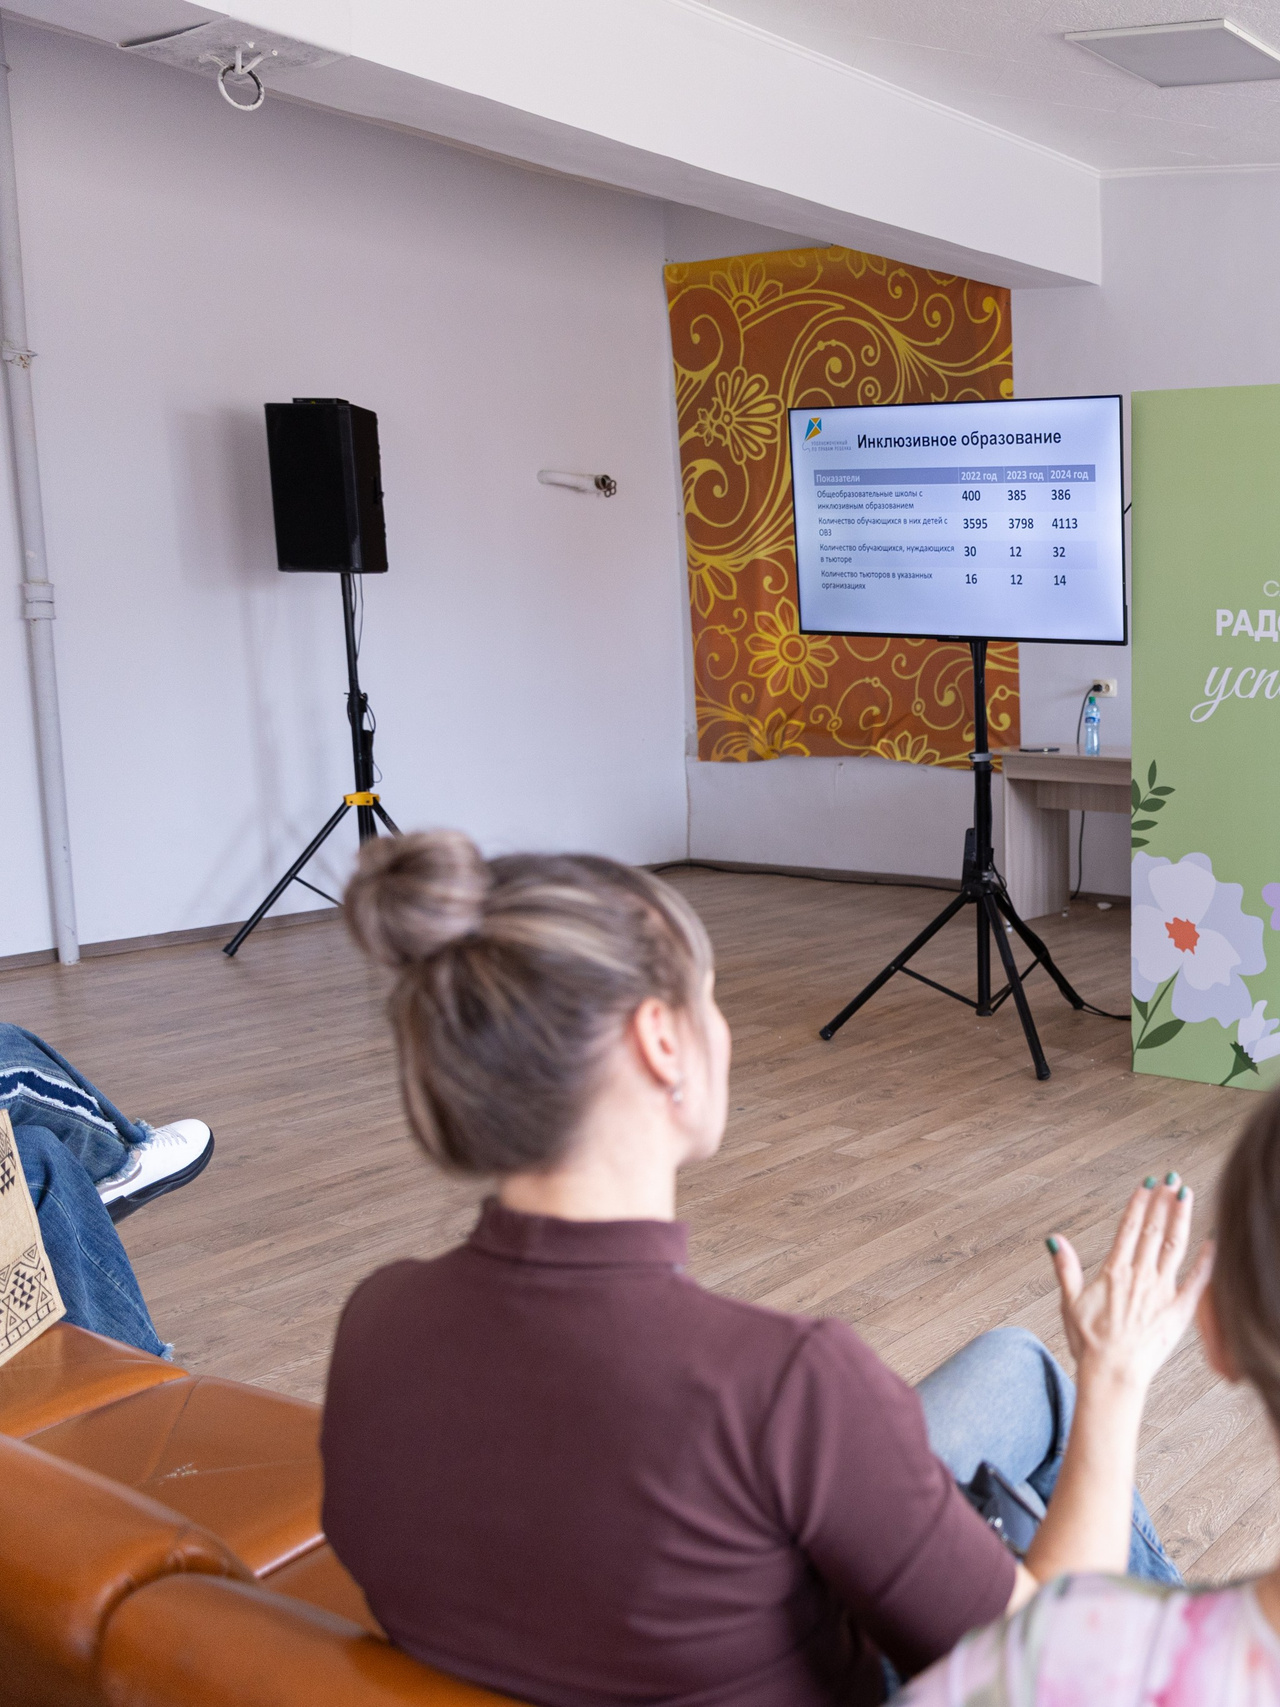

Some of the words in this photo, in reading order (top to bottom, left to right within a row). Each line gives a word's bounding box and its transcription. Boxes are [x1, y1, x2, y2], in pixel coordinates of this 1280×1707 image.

[858, 434, 957, 449] Инклюзивное
[961, 430, 1062, 449] образование
[816, 474, 860, 483] Показатели
[961, 471, 981, 481] 2022
[982, 472, 998, 483] год
[1007, 470, 1027, 480] 2023
[1028, 472, 1044, 482] год
[1050, 470, 1072, 480] 2024
[1074, 471, 1089, 481] год
[817, 490, 893, 499] Общеобразовательные
[962, 490, 981, 501] 400
[1008, 490, 1027, 501] 385
[1051, 489, 1070, 500] 386
[865, 502, 914, 511] образованием
[819, 517, 855, 525] Количество
[857, 517, 901, 527] обучающихся
[923, 516, 942, 526] детей
[963, 518, 988, 530] 3595
[1008, 518, 1034, 530] 3798
[1052, 518, 1078, 529] 4113
[819, 528, 832, 537] ОВЗ
[820, 544, 856, 552] Количество
[858, 544, 904, 554] обучающихся,
[906, 545, 955, 553] нуждающихся
[964, 546, 977, 557] 30
[1010, 546, 1022, 558] 12
[1053, 546, 1066, 558] 32
[826, 556, 852, 564] тьюторе
[821, 570, 857, 578] Количество
[897, 572, 933, 580] указанных
[965, 574, 977, 585] 16
[1010, 574, 1022, 585] 12
[1053, 575, 1066, 586] 14
[822, 582, 866, 590] организациях
